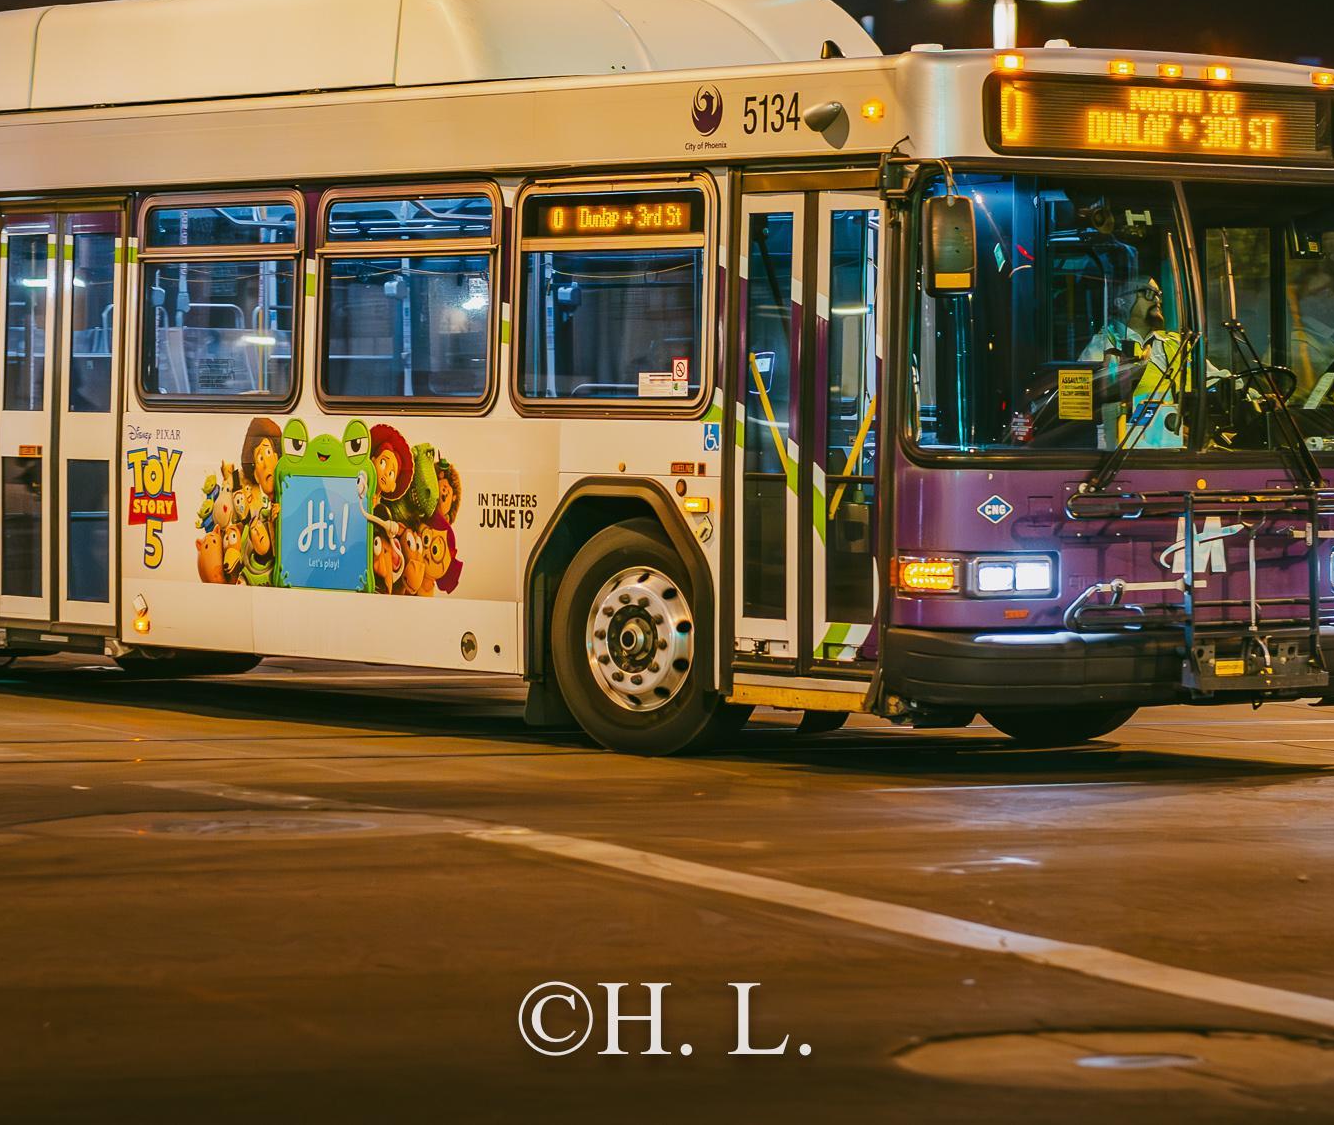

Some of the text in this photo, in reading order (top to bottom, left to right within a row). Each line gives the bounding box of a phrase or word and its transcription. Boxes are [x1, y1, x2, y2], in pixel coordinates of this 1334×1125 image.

[1130, 89, 1237, 114] NORTH TO
[743, 92, 801, 135] 5134
[1087, 110, 1172, 146] DUNLAP
[1199, 116, 1242, 149] 3RD
[1247, 118, 1276, 149] ST
[684, 141, 727, 152] City of Phoenix
[579, 206, 620, 228] Dunlap
[637, 205, 662, 227] 3rd
[666, 205, 682, 226] St
[127, 425, 181, 444] Disney PIXAR
[127, 447, 183, 498] TOY
[133, 499, 174, 515] STORY
[478, 493, 538, 508] IN THEATERS
[984, 504, 1007, 516] CNG
[298, 500, 349, 555] Hi!
[479, 508, 534, 530] JUNE 19
[144, 516, 164, 569] 5
[308, 558, 340, 571] Let's play!
